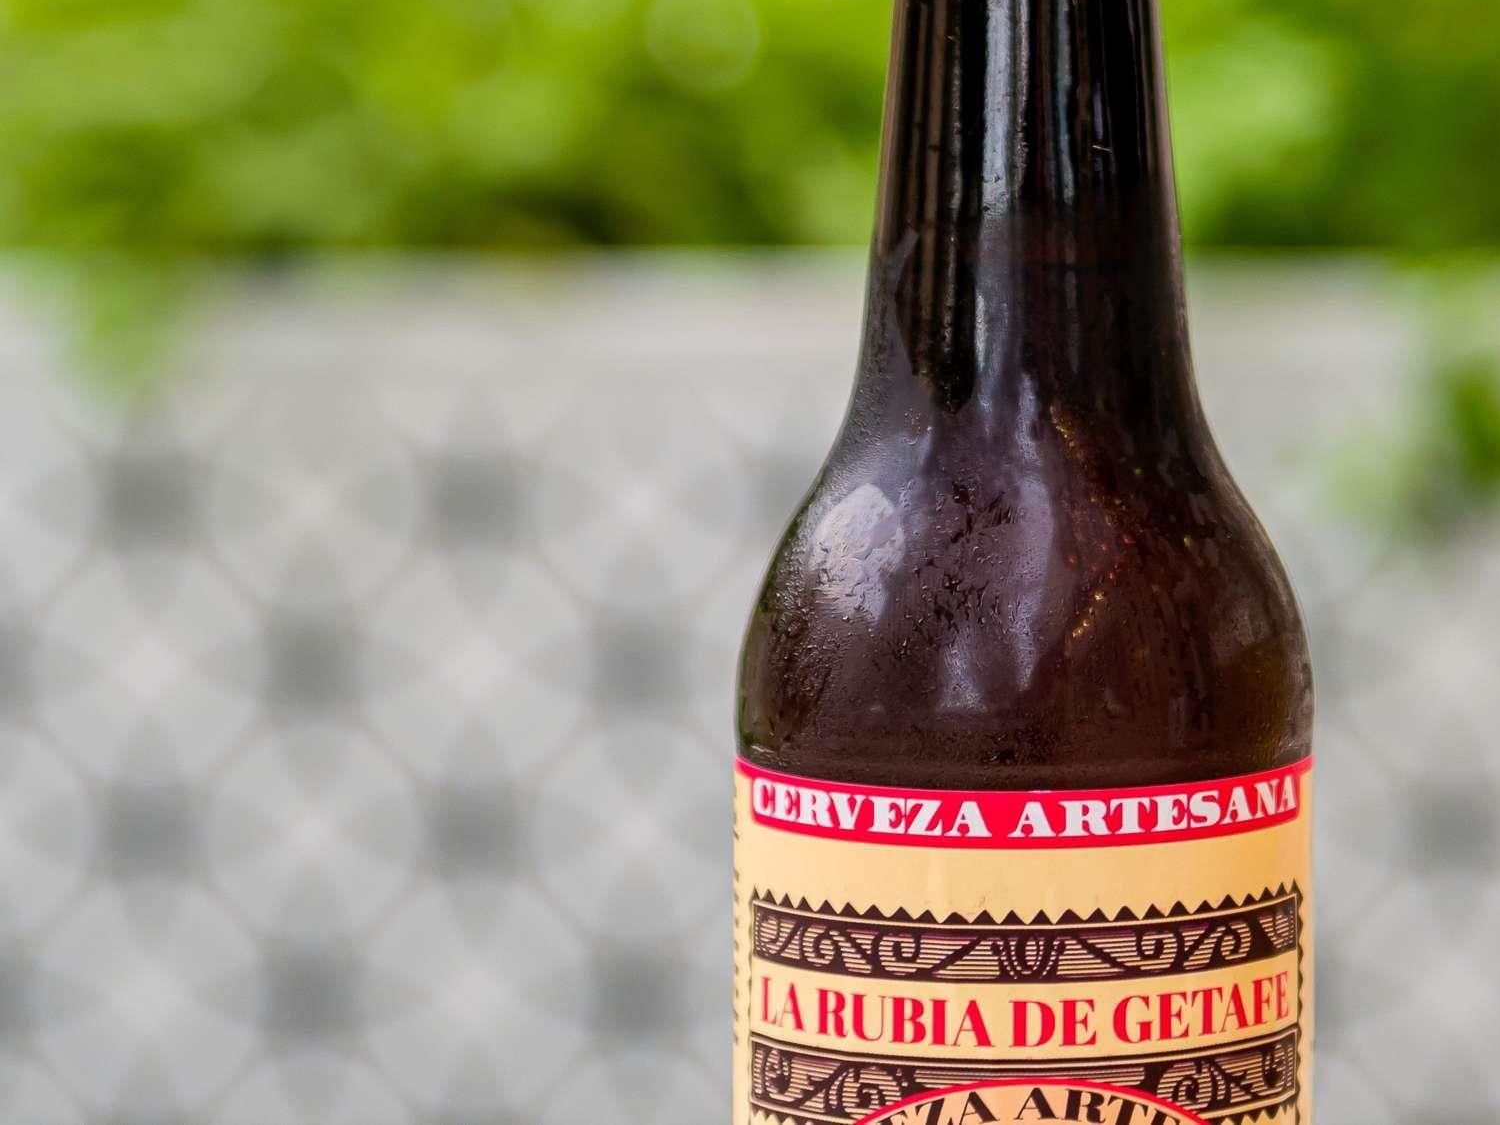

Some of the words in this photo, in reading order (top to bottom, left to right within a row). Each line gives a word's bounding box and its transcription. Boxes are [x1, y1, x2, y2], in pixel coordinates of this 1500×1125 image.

[752, 777, 993, 838] CERVEZA
[1008, 775, 1298, 838] ARTESANA
[760, 977, 806, 1031] LA
[817, 988, 994, 1046] RUBIA
[1010, 999, 1098, 1047] DE
[1112, 971, 1290, 1043] GETAFE
